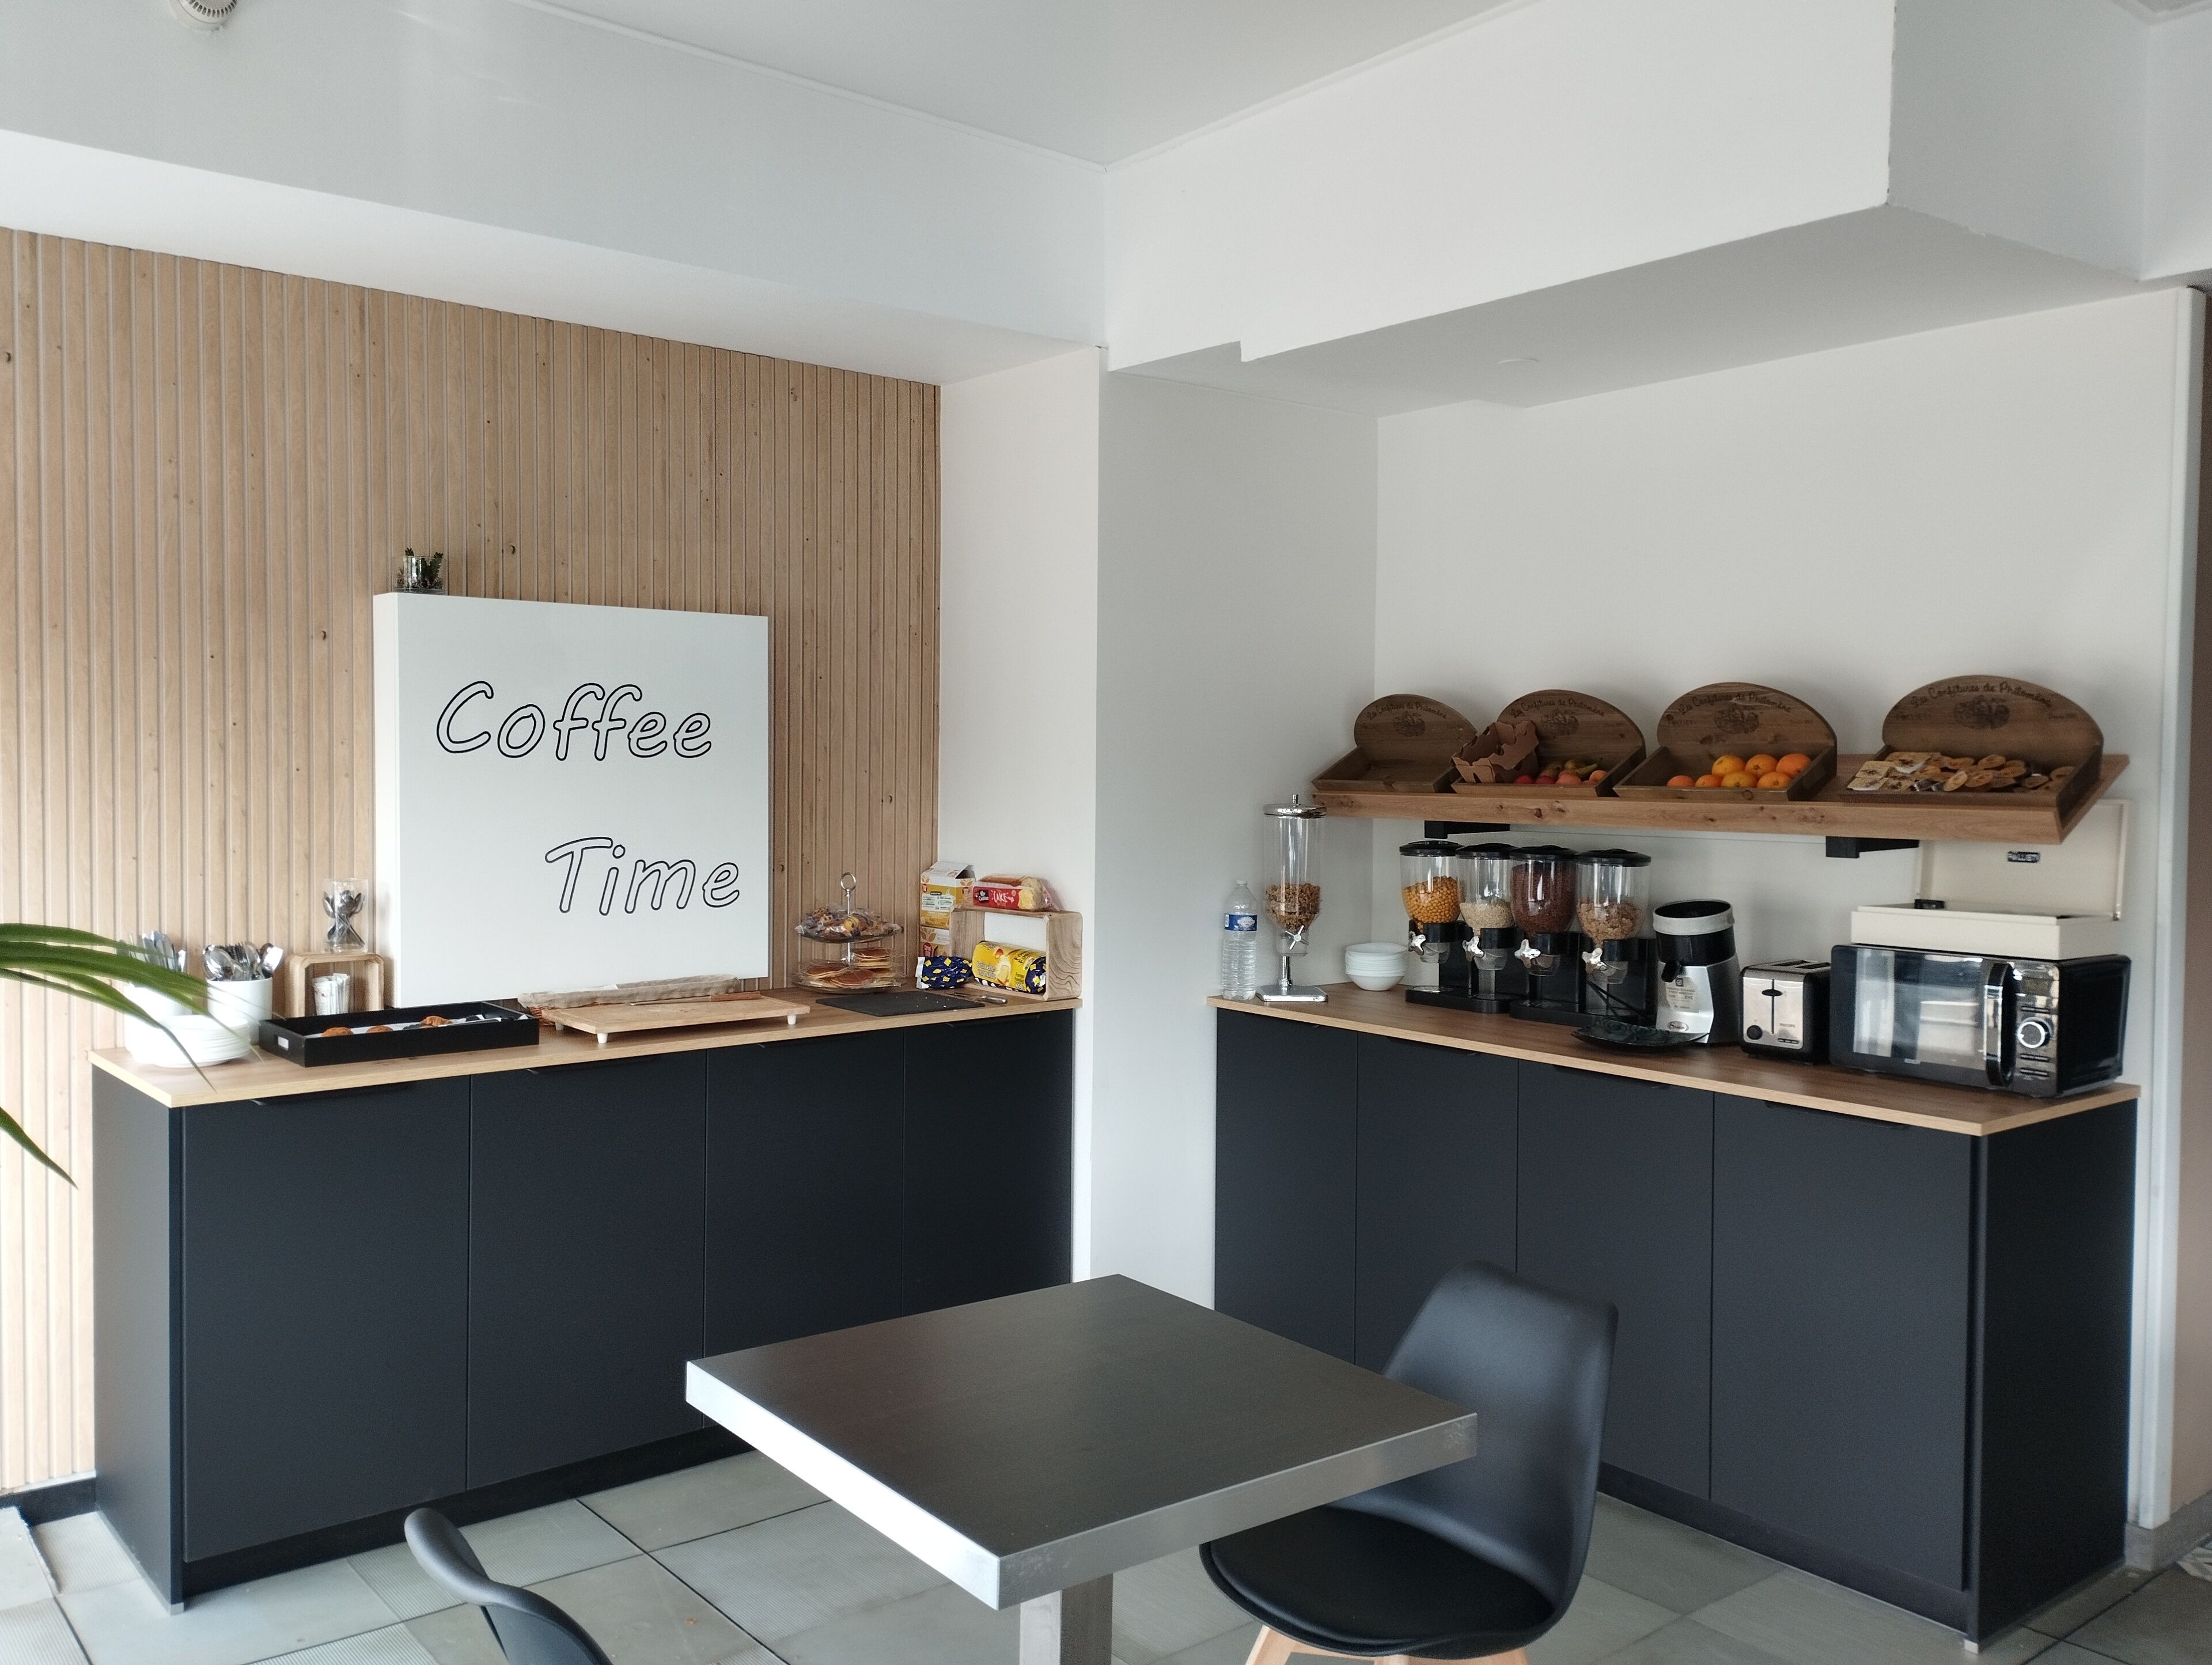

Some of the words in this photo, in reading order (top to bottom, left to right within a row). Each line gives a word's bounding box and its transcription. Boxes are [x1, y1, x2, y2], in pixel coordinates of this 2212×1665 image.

[1521, 700, 1555, 712] Confitures
[1928, 684, 1980, 699] Confitures
[1983, 683, 1995, 692] de
[437, 681, 711, 761] Coffee
[545, 837, 740, 916] Time
